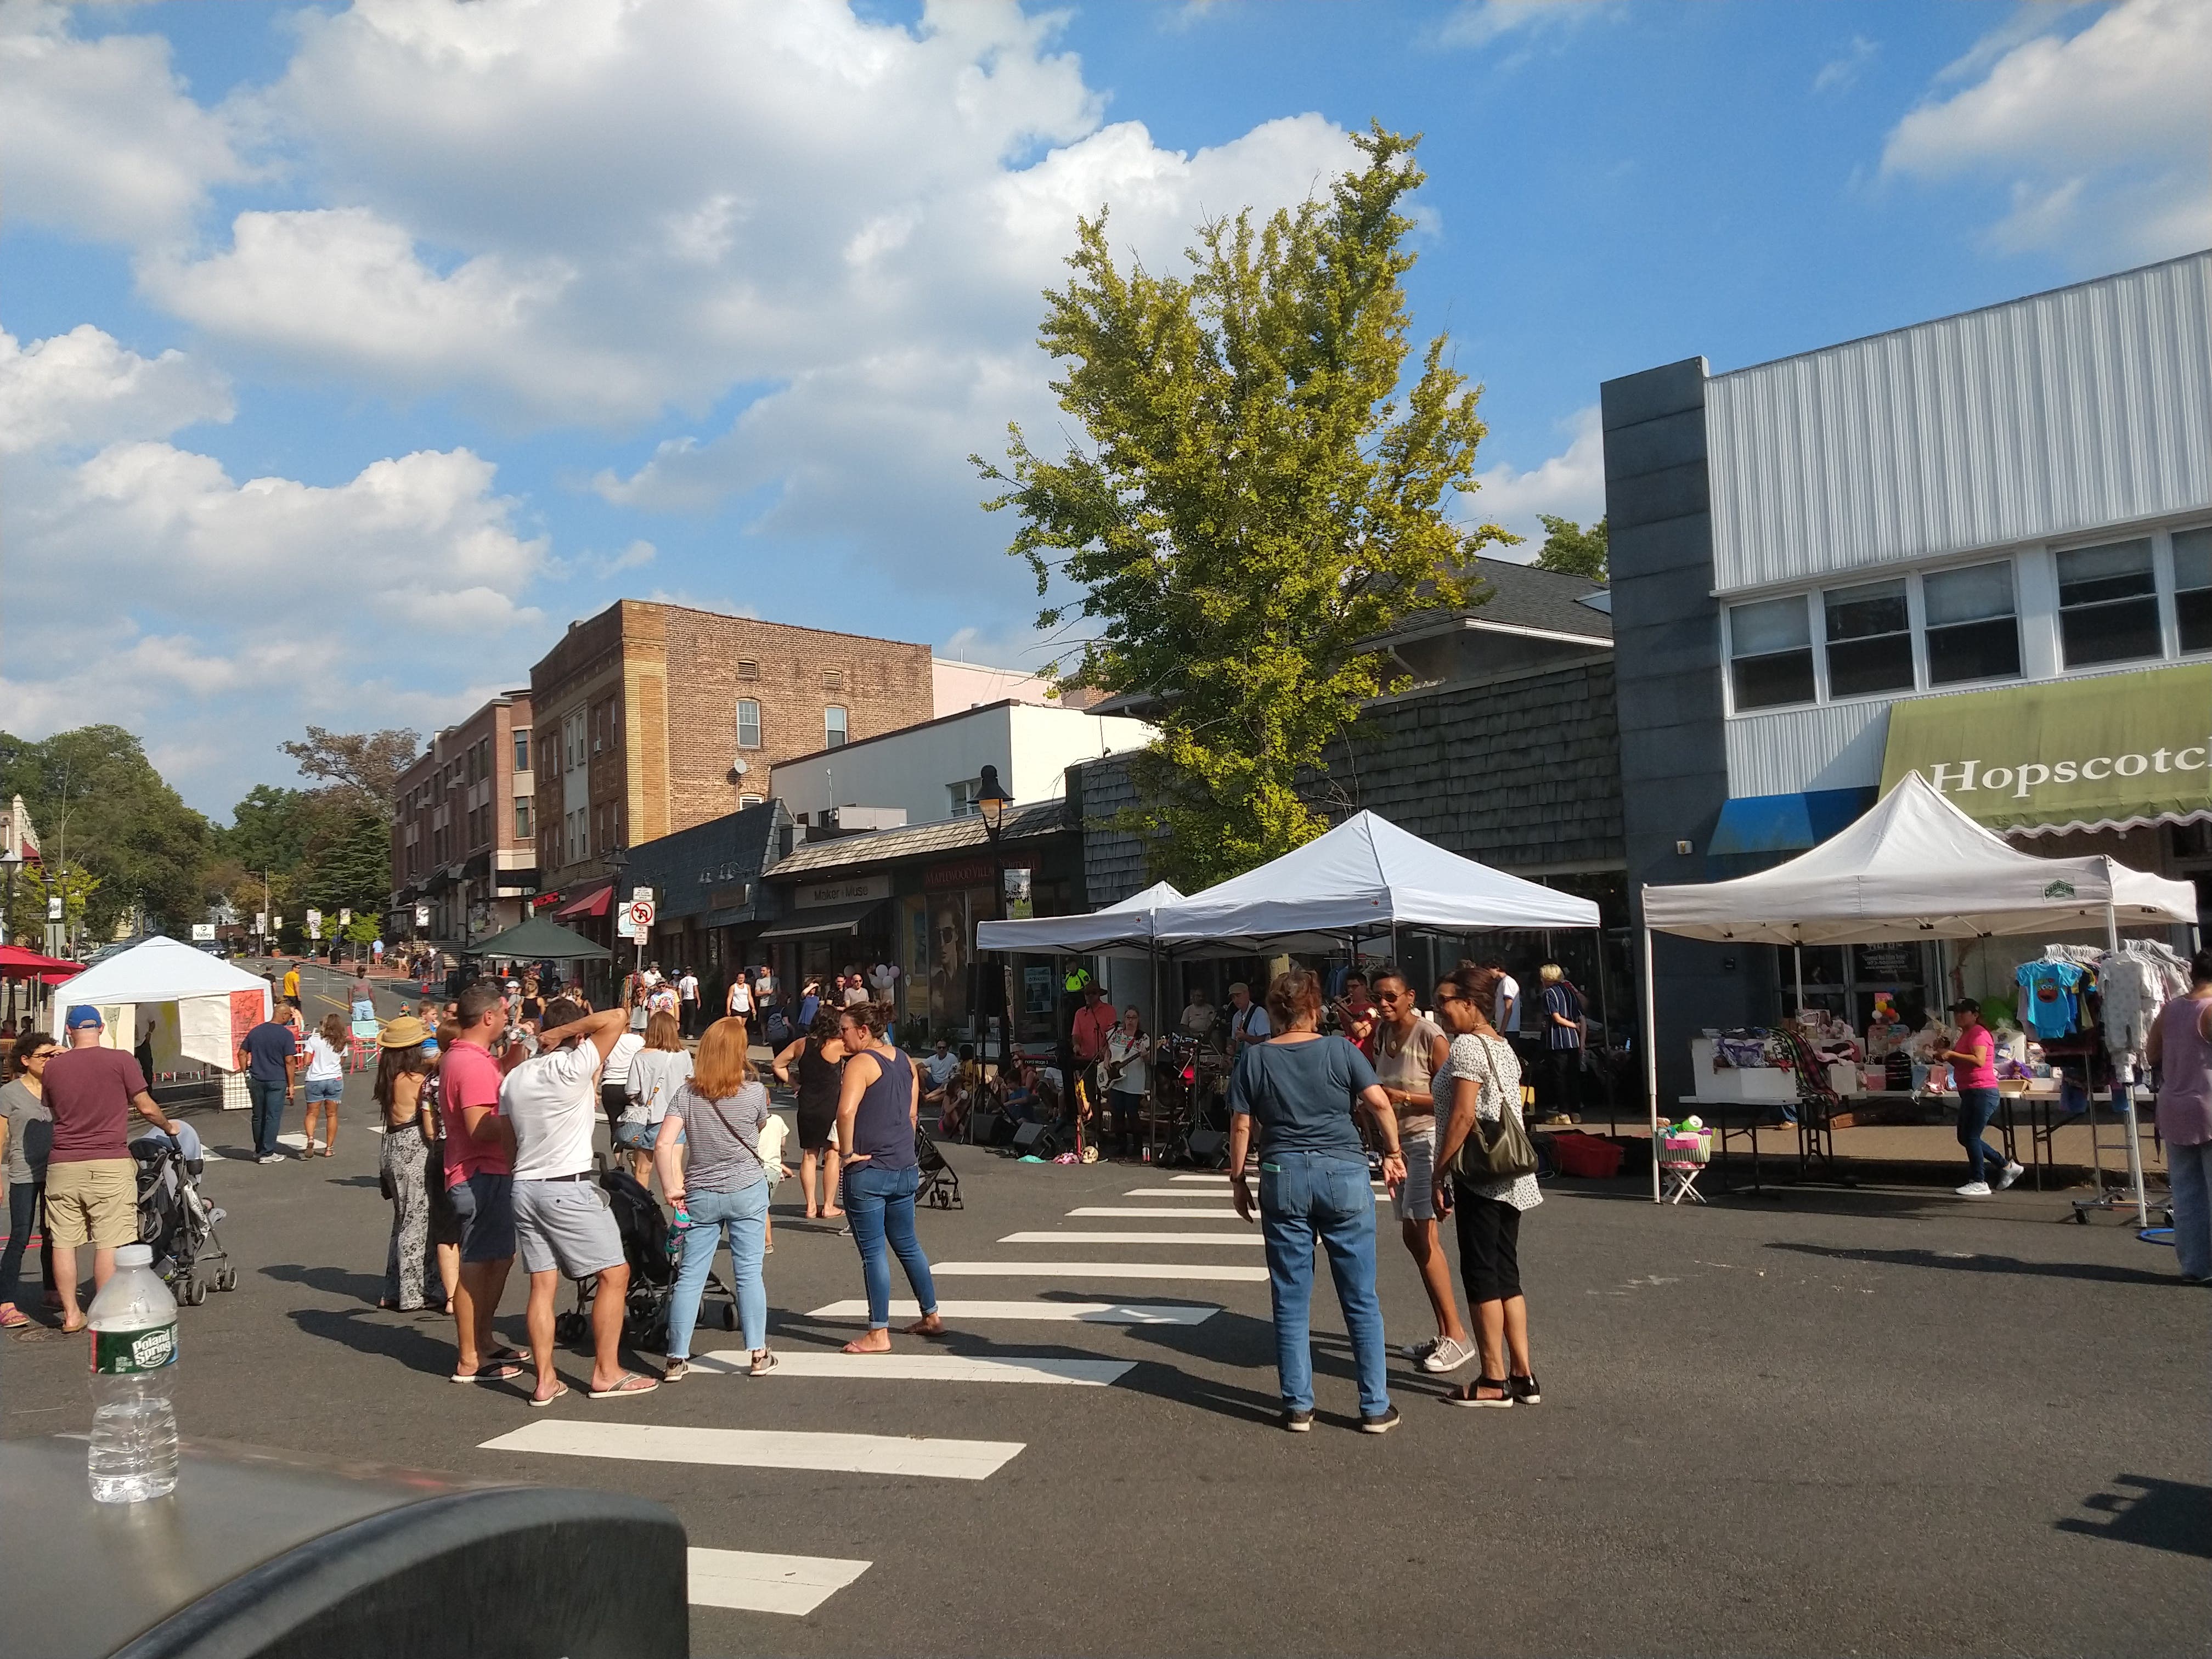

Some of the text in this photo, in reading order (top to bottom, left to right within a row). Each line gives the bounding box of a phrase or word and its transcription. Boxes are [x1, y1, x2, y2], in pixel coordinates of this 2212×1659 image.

[926, 868, 971, 883] MAPLEWOOD
[972, 864, 996, 878] VILLA
[814, 889, 840, 901] Maker
[845, 886, 868, 897] Muse
[2045, 882, 2075, 897] CARAVAN
[132, 1328, 171, 1356] Poland
[135, 1340, 172, 1365] Spring
